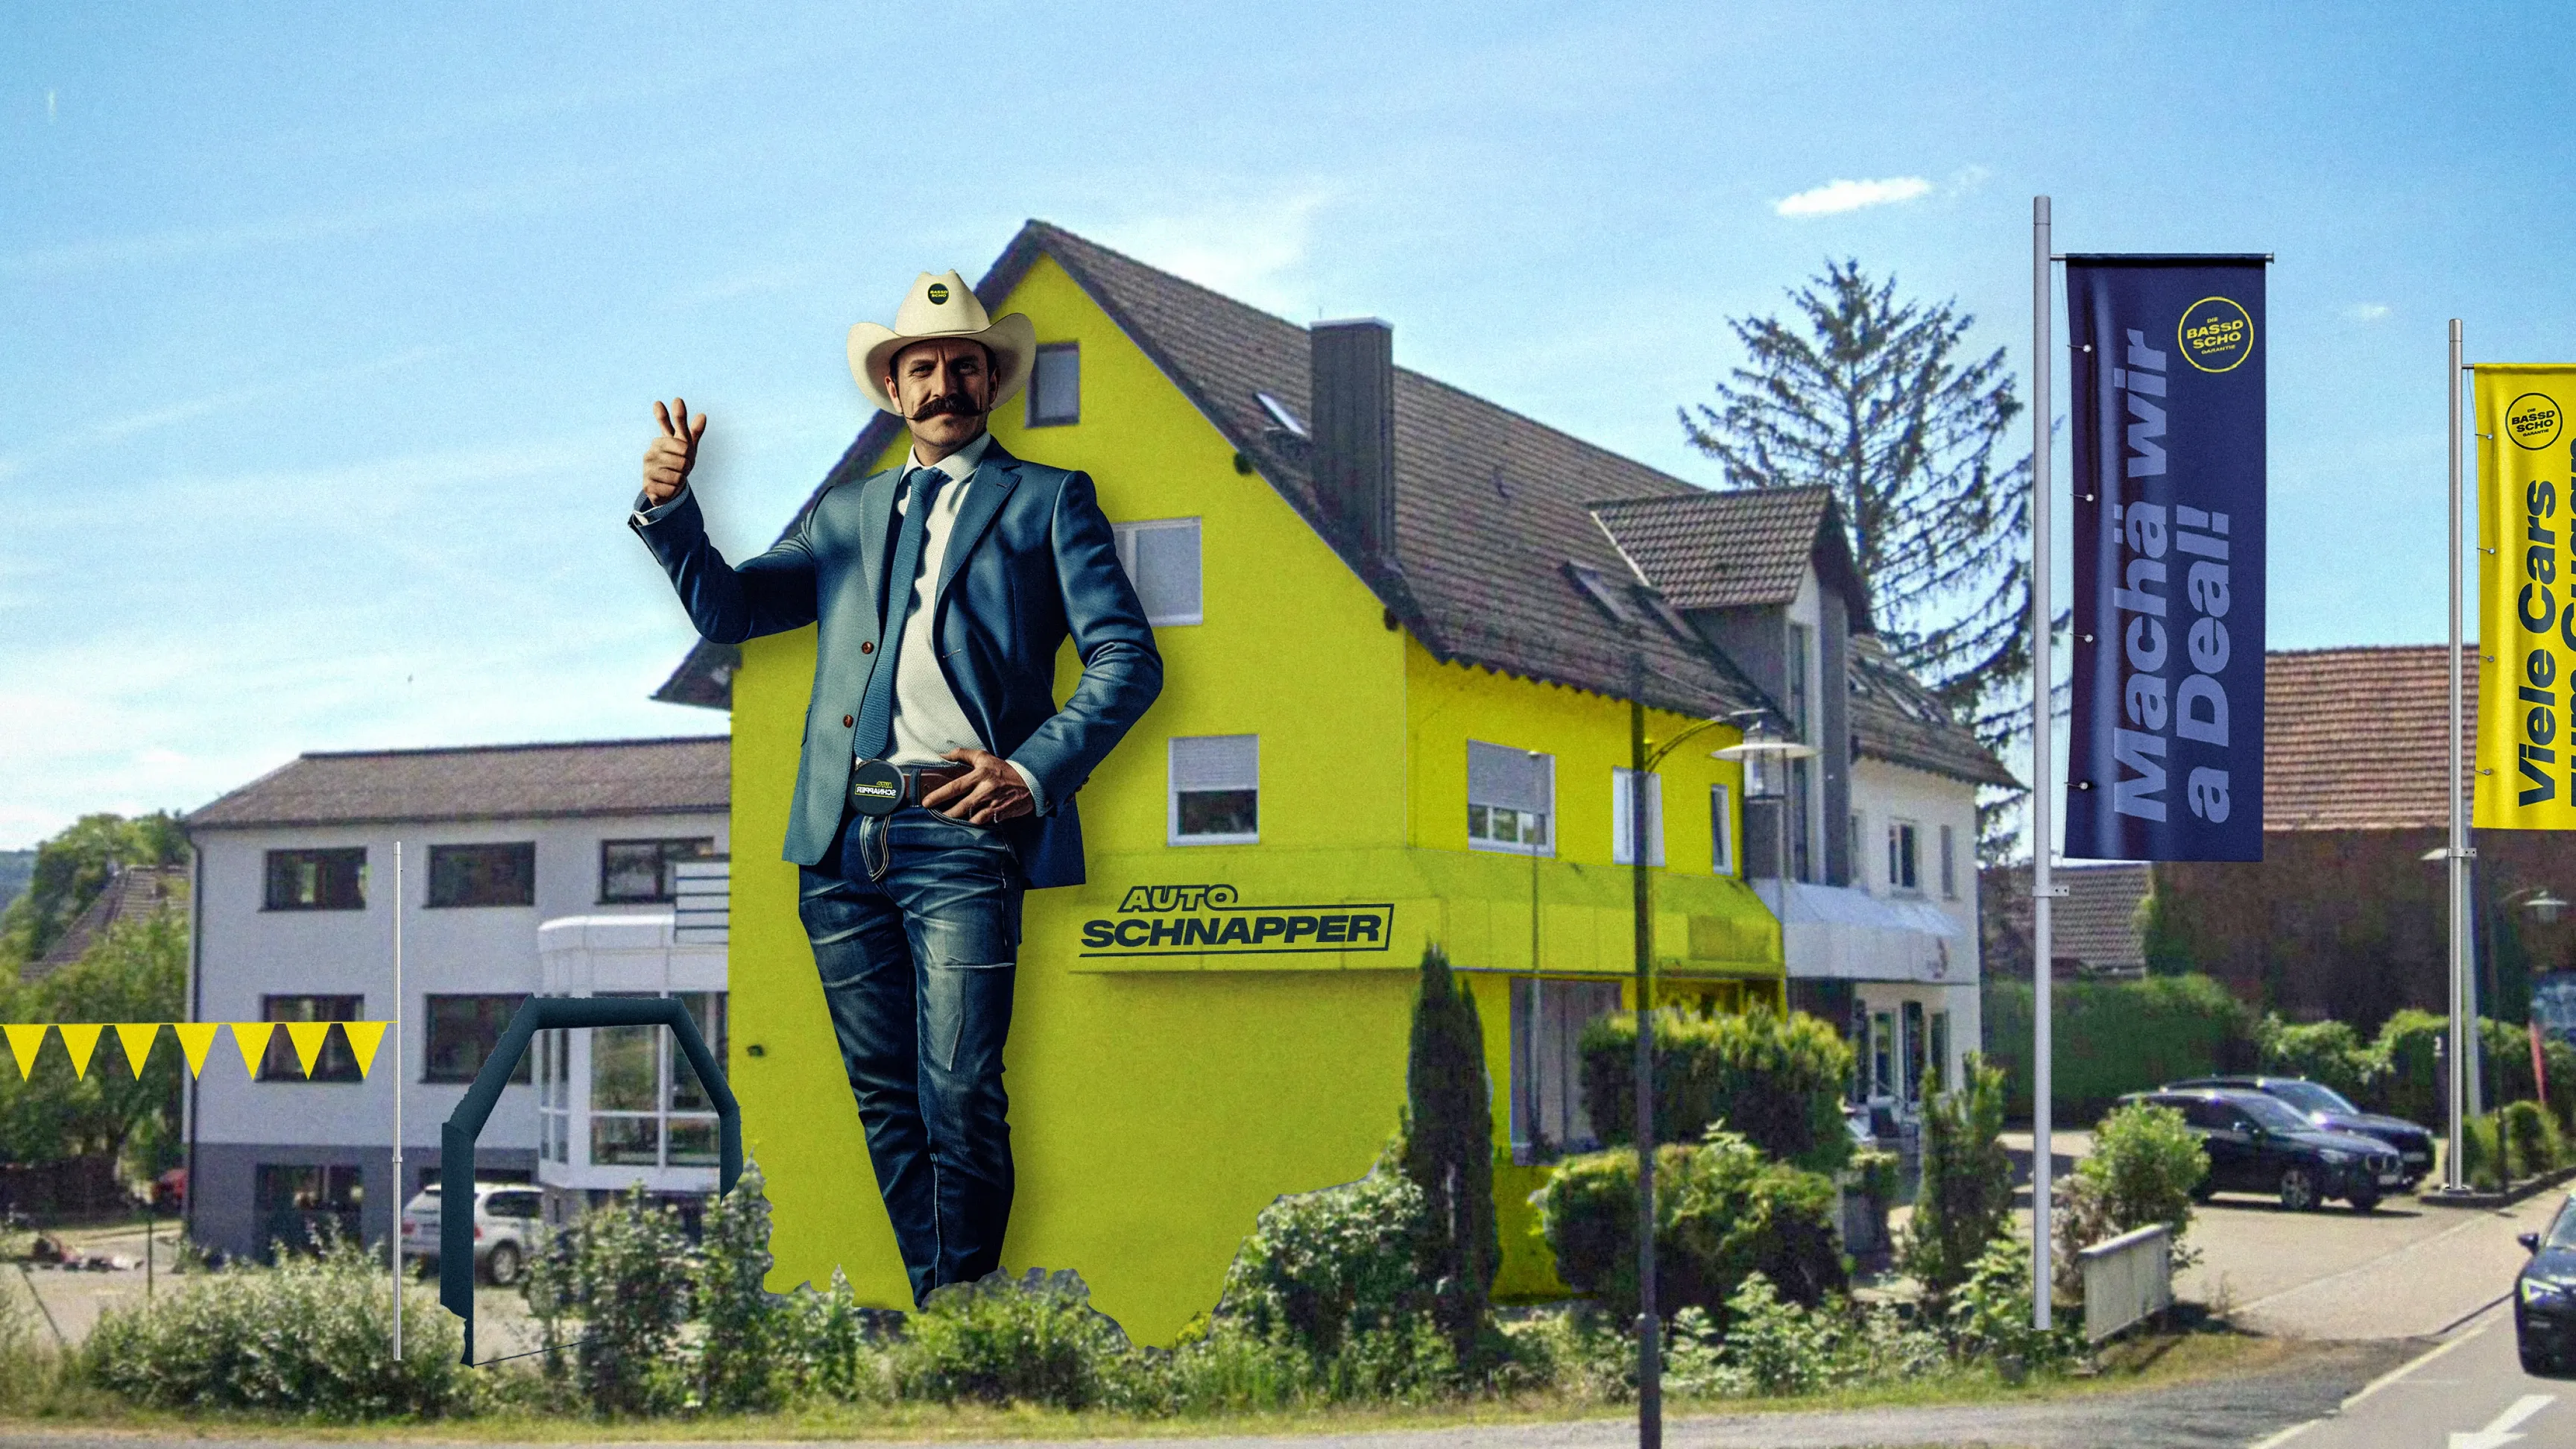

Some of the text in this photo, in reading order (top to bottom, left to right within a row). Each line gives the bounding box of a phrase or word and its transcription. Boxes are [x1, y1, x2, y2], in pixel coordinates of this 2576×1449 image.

[2187, 320, 2244, 339] BASSD
[2193, 331, 2241, 349] SCHO
[2201, 344, 2235, 355] GARANTIE
[2511, 411, 2555, 425] BASSD
[2516, 420, 2554, 432] SCHO
[2522, 429, 2549, 437] GARANTIE
[2113, 329, 2168, 823] Machä wir
[2518, 481, 2555, 807] Viele Cars
[2176, 505, 2229, 824] a Deal!
[1118, 884, 1238, 913] AUTO
[1082, 915, 1382, 948] SCHNAPPER
